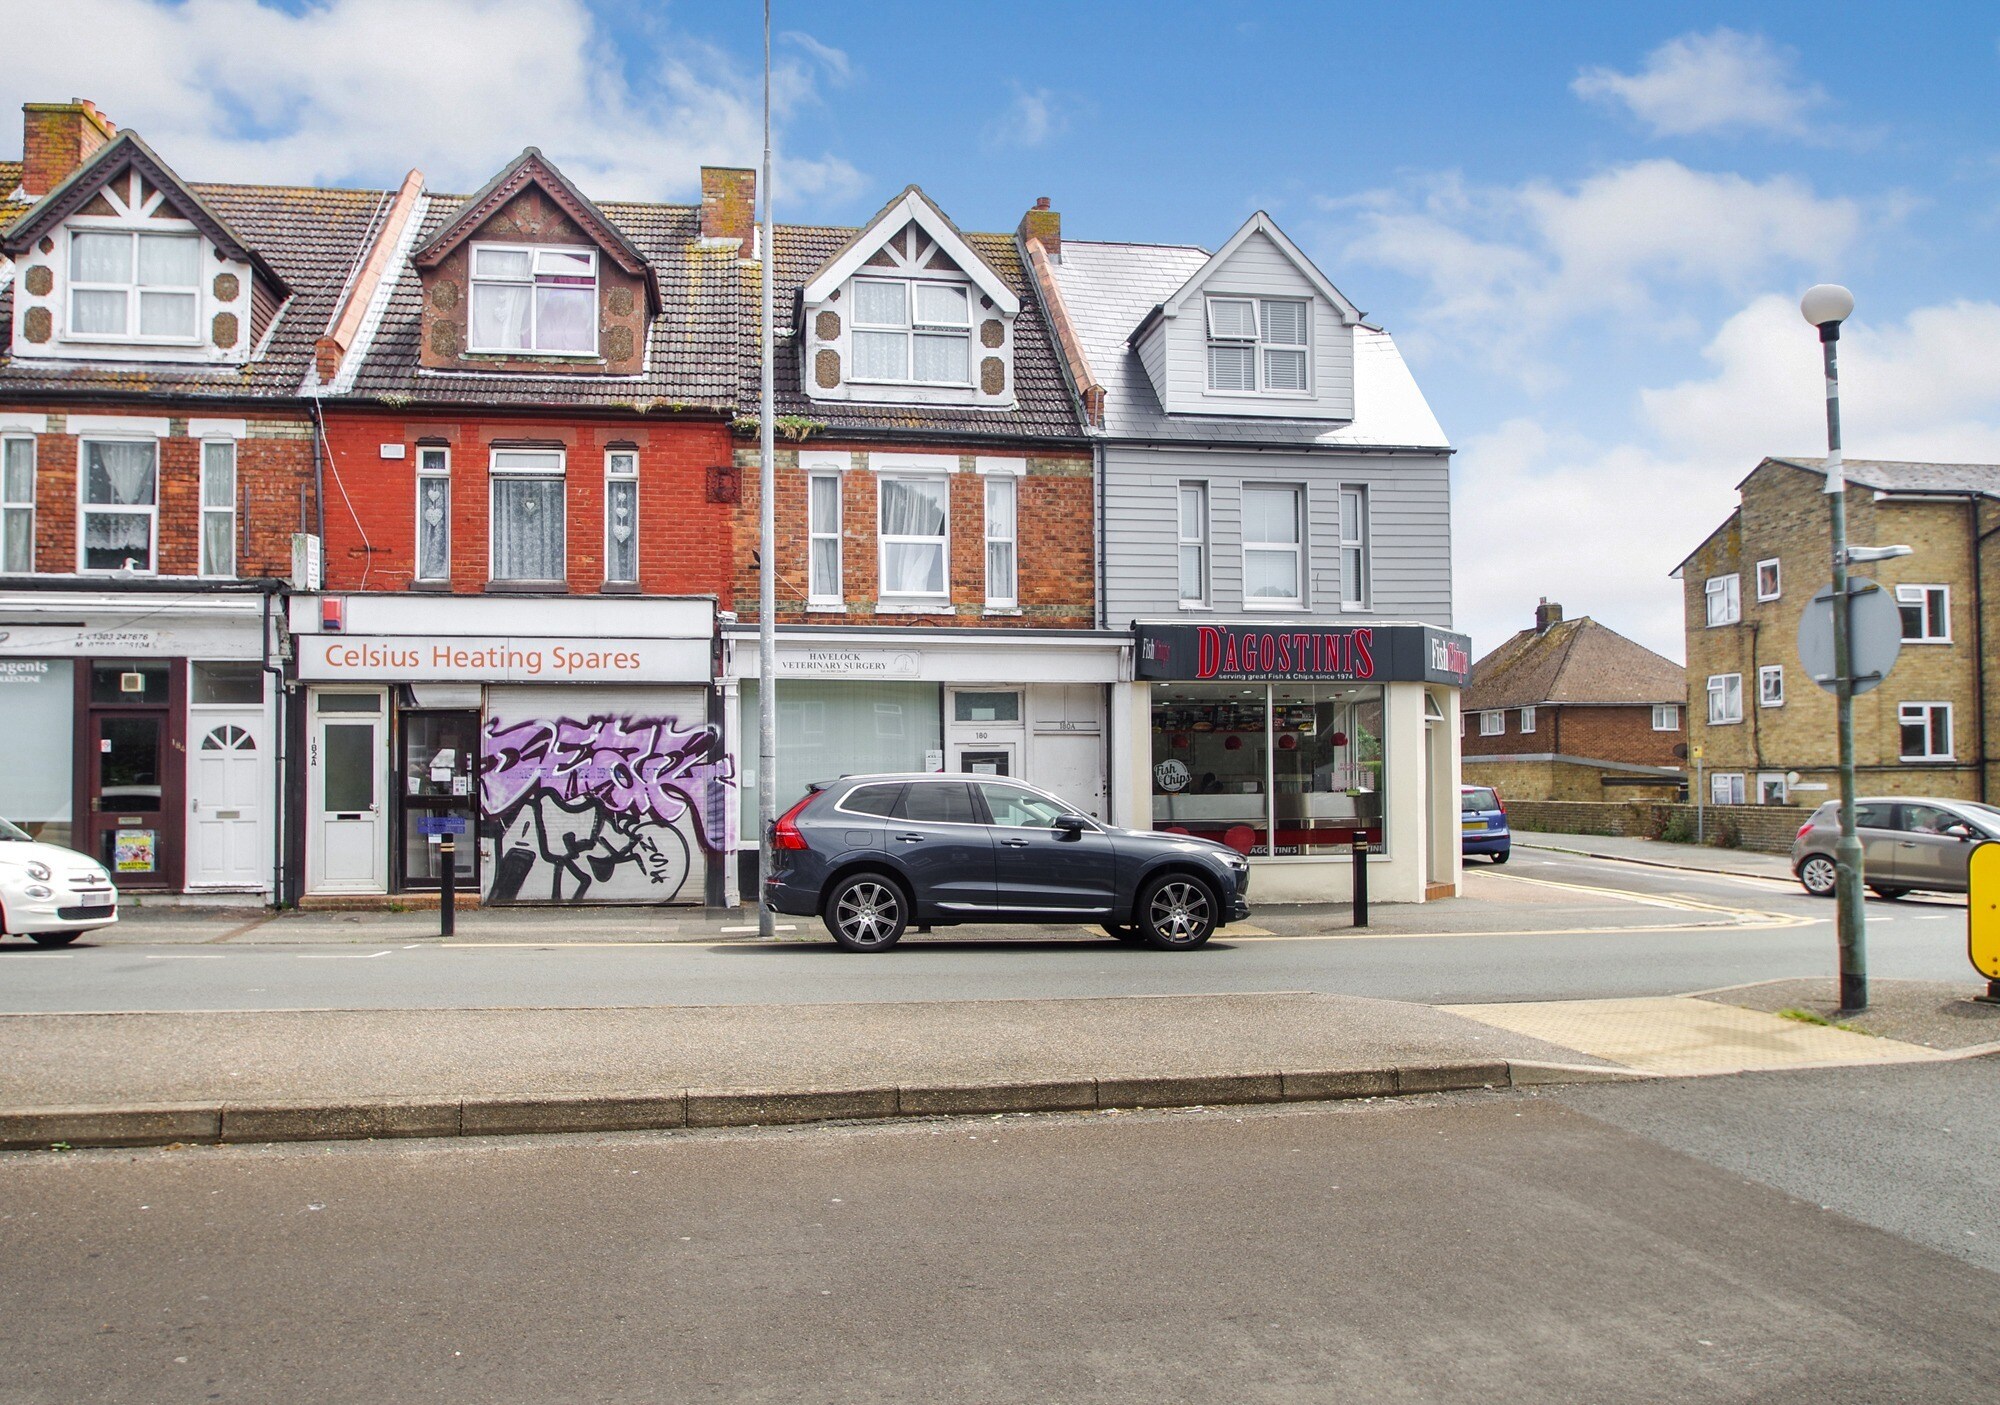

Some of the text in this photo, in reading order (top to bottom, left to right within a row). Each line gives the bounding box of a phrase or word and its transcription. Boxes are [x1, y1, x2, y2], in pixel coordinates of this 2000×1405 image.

[325, 643, 641, 674] Celsius Heating Spares
[809, 653, 861, 661] HAVELOCK
[1431, 638, 1448, 671] Fish
[782, 661, 888, 670] VETERINARY SURGERY
[1292, 673, 1314, 681] Chips
[1155, 764, 1177, 776] Fish
[1163, 773, 1191, 787] Chips
